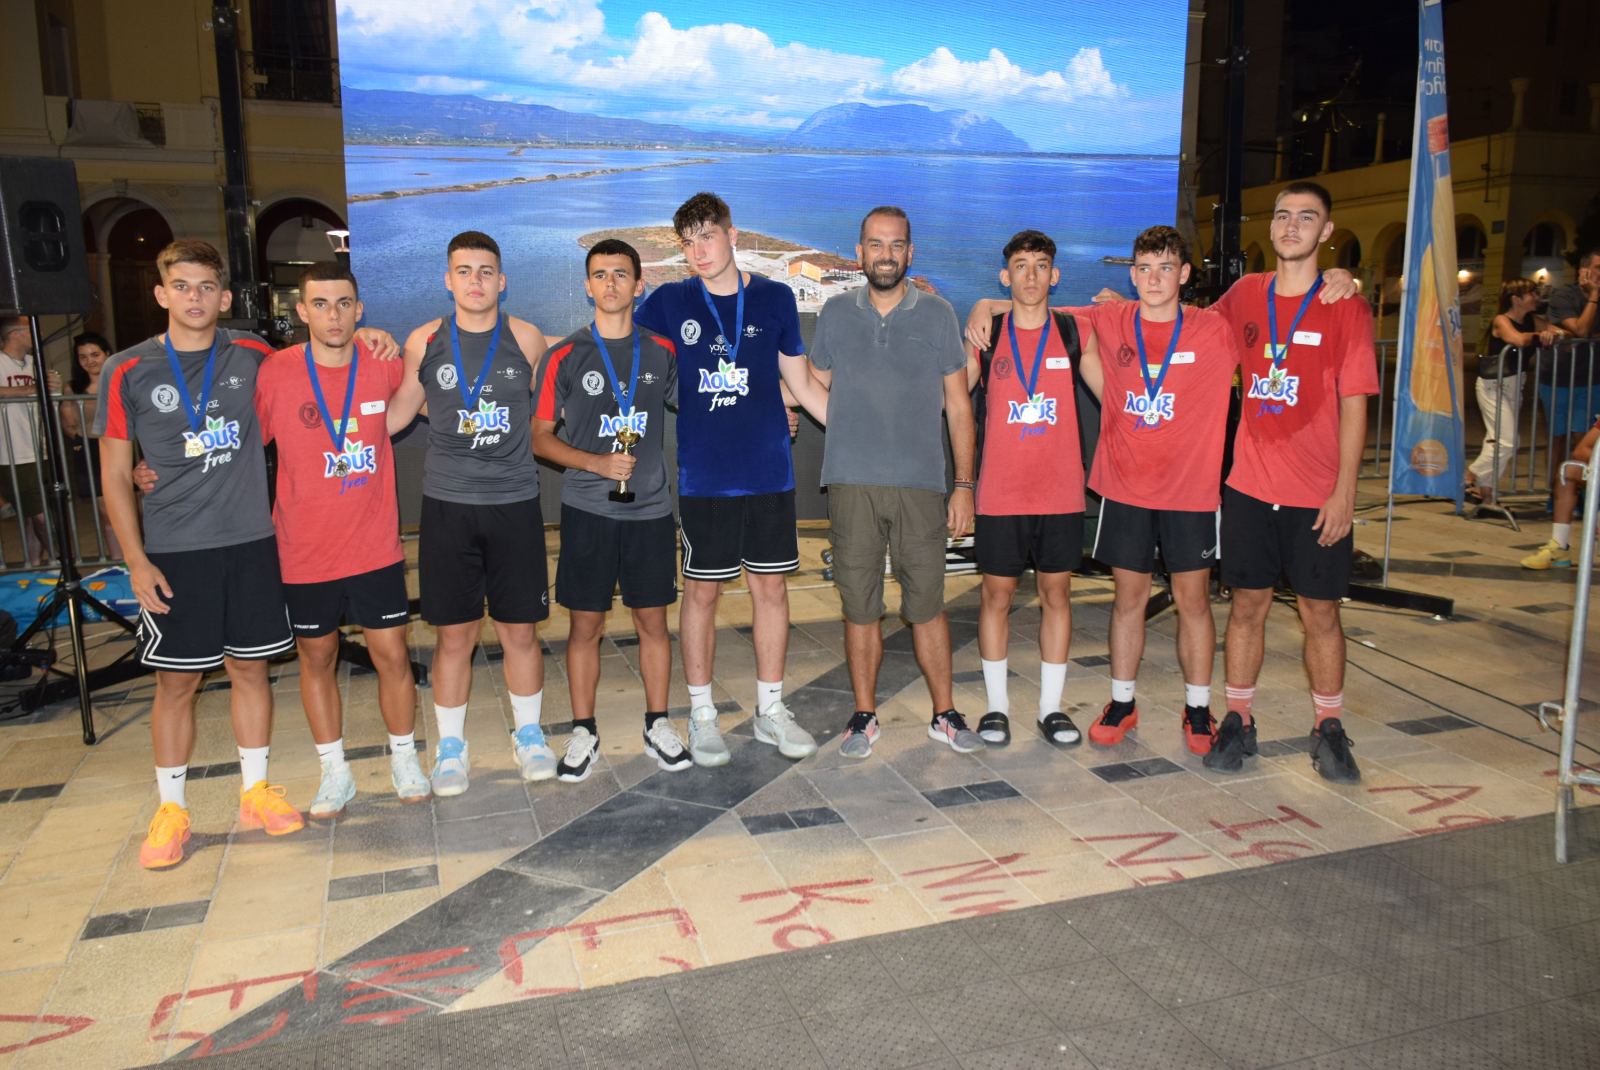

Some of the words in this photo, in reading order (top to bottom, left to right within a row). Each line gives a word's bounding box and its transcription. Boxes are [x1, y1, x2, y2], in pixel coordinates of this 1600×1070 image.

[709, 393, 737, 411] free
[470, 432, 501, 450] free
[202, 452, 232, 473] free
